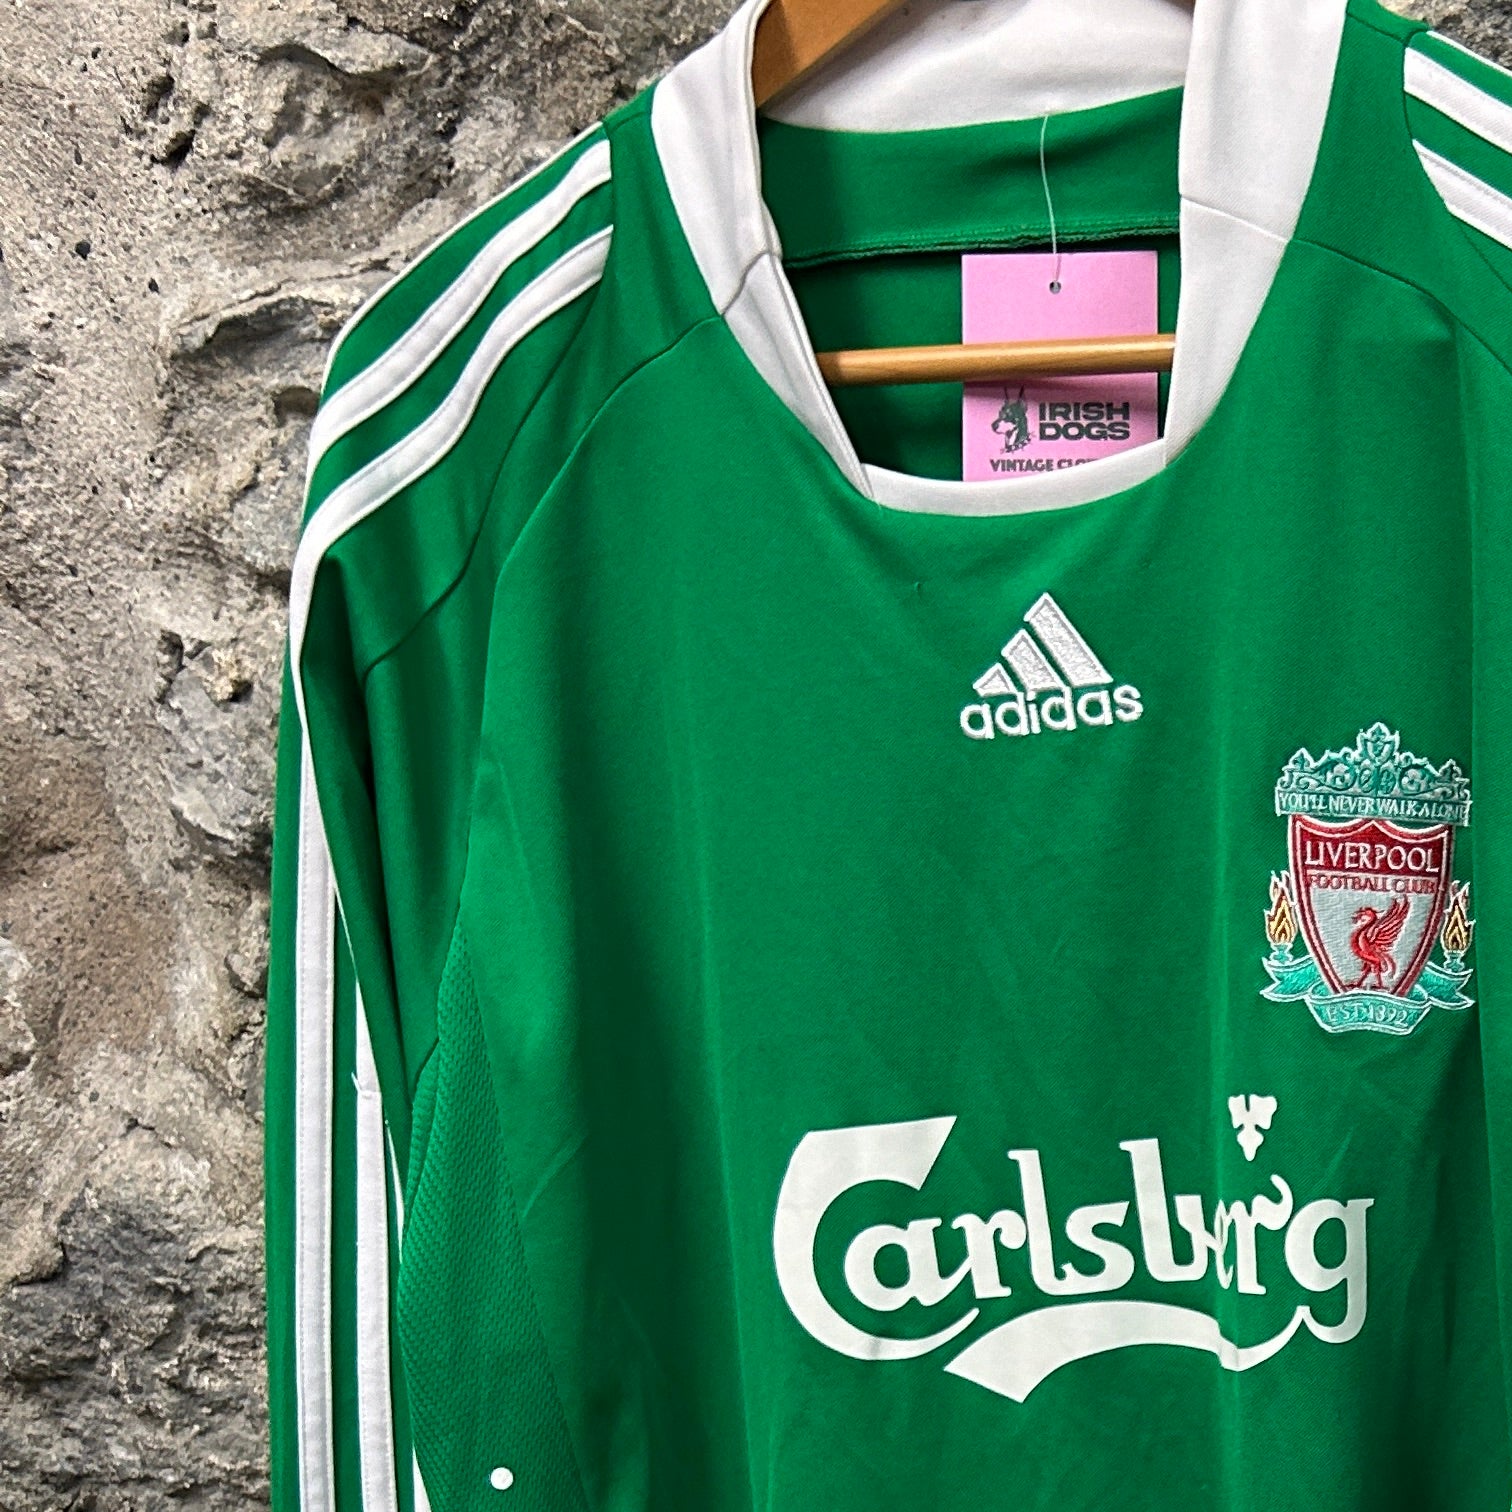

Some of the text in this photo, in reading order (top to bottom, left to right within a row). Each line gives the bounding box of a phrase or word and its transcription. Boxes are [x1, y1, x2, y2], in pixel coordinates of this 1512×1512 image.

[1039, 401, 1130, 420] IRISH
[1039, 422, 1130, 440] DOGS
[990, 458, 1053, 472] VINTAGE
[960, 684, 1143, 740] adidas
[1329, 795, 1374, 814] NEVER
[1377, 798, 1418, 816] WALK
[1304, 840, 1440, 873] LIVERPOOL
[1309, 873, 1438, 894] FOOTBALL CLUB
[773, 1115, 1375, 1403] Carlsberg
